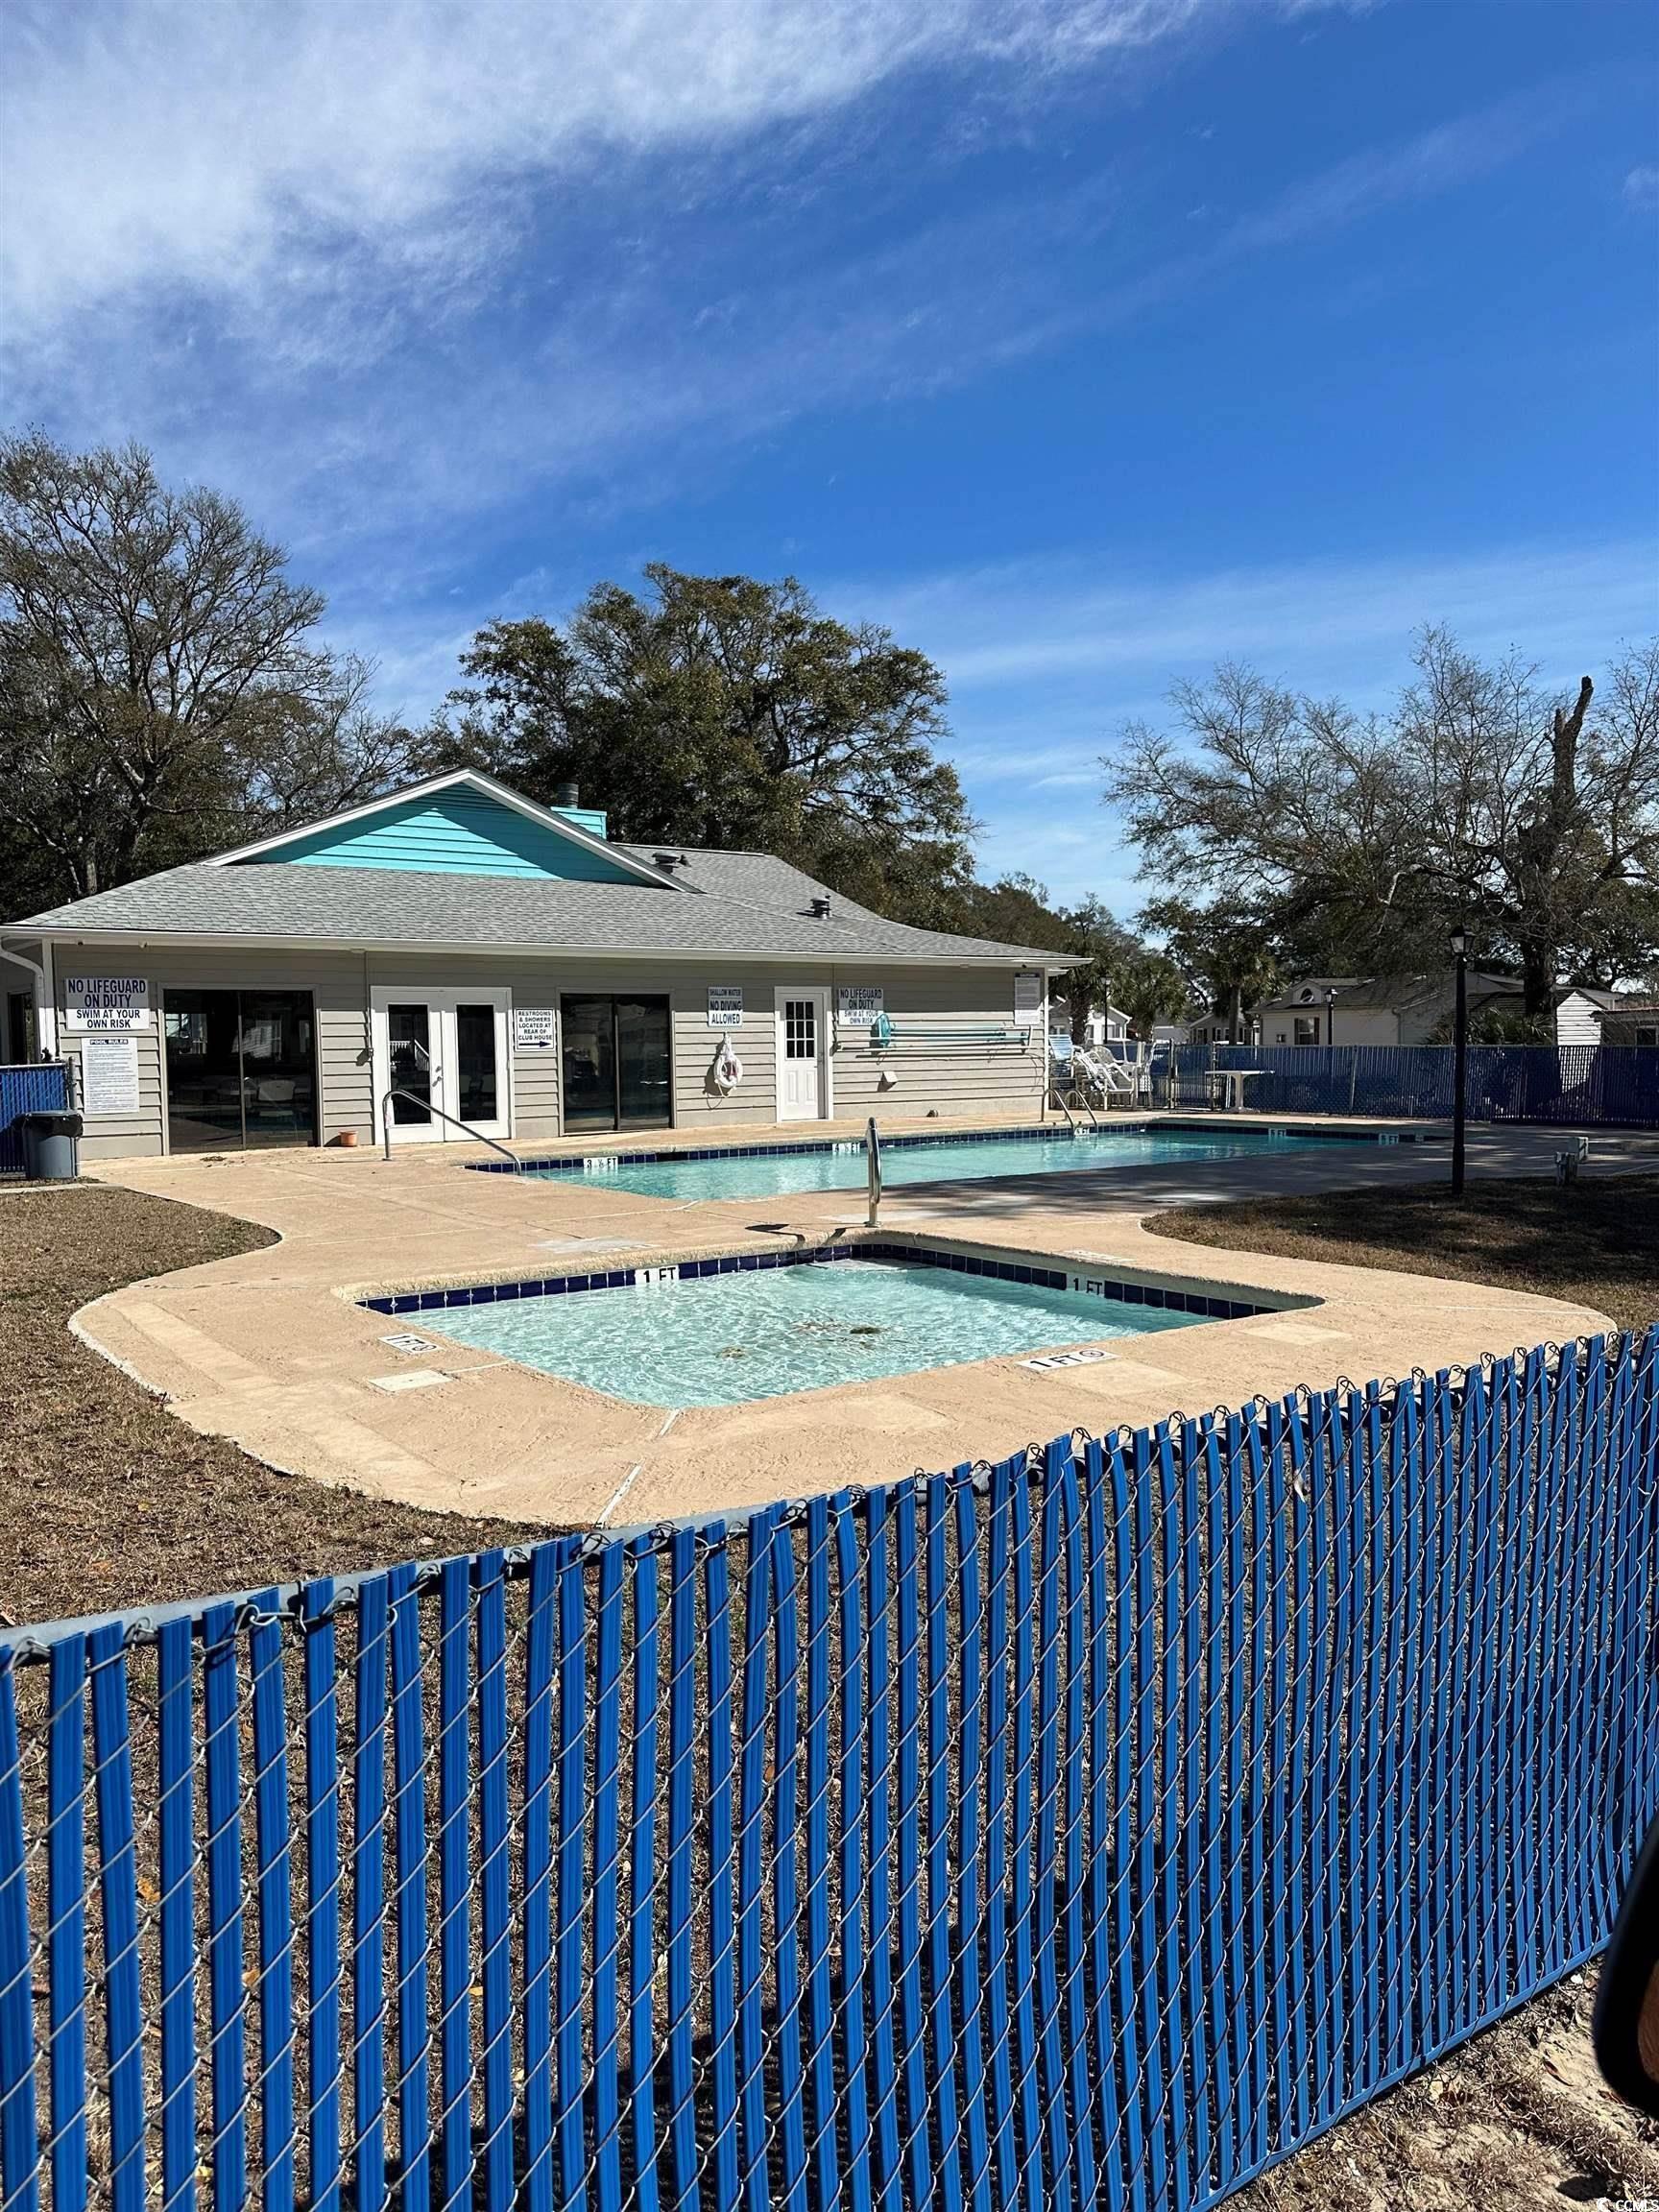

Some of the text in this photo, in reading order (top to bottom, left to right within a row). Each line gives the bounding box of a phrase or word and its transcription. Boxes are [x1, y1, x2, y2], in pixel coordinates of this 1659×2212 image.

[68, 979, 146, 994] NO LIFEGUARD
[840, 989, 882, 999] NO LIFEGUARD
[84, 994, 132, 1008] ON DUTY
[710, 999, 742, 1011] NO DIVING
[849, 998, 875, 1010] ON DUTY
[77, 1009, 140, 1019] SWIM AT YOUR
[711, 1013, 741, 1024] ALLOWED
[87, 1019, 131, 1028] OWN RISK
[607, 1157, 616, 1169] FT
[643, 1266, 676, 1284] 1 FT
[1073, 1277, 1103, 1296] 1 FT
[1048, 1355, 1082, 1365] FT
